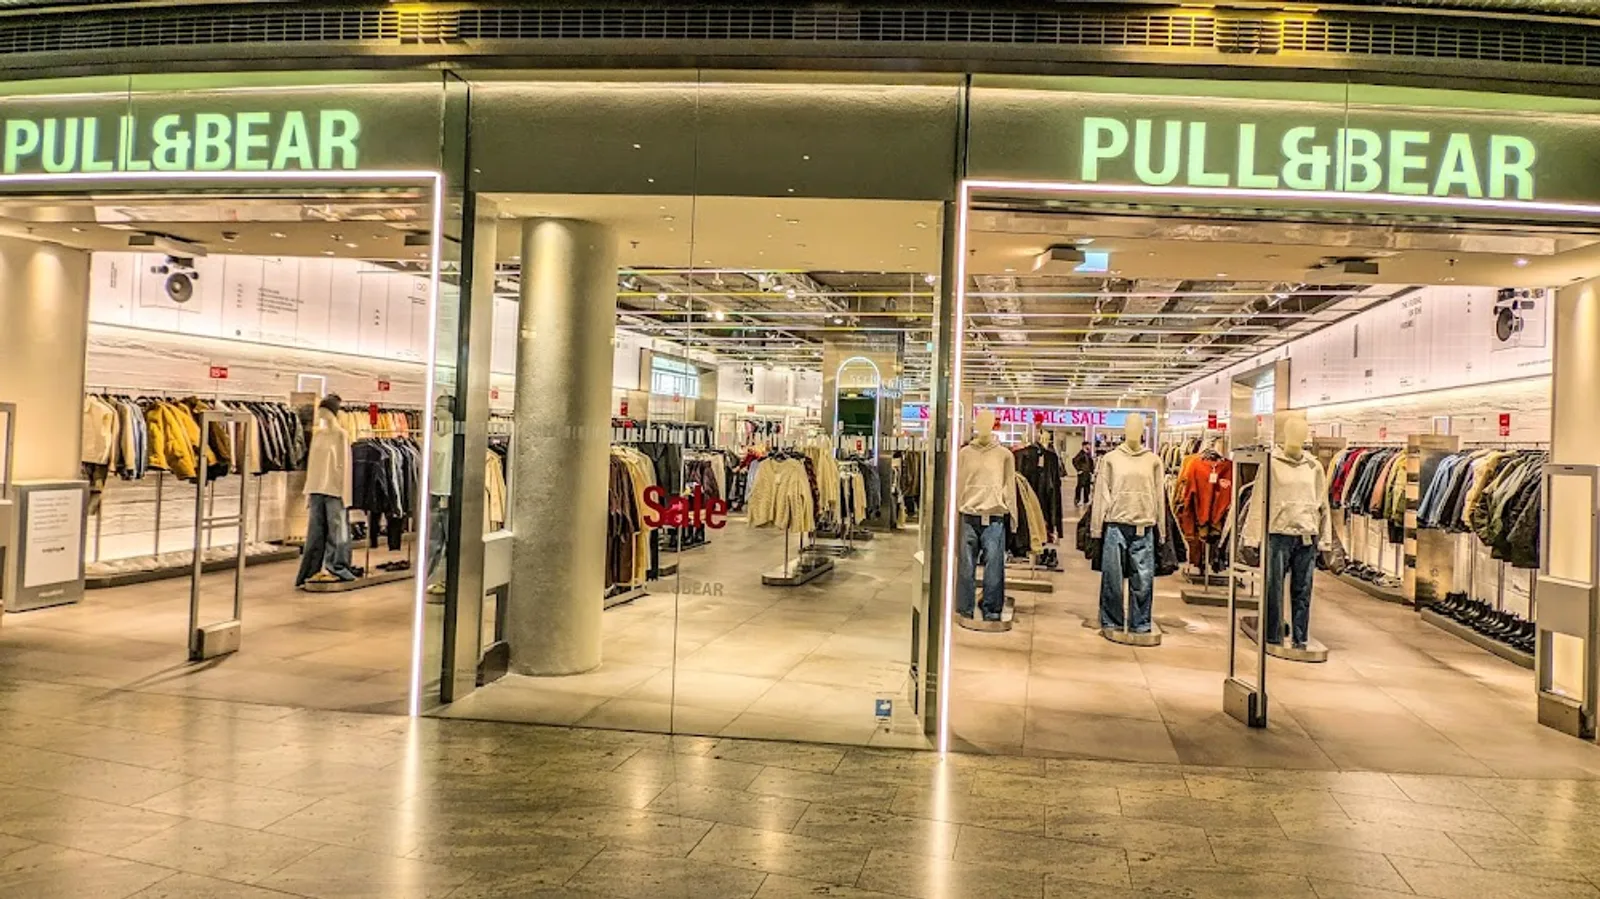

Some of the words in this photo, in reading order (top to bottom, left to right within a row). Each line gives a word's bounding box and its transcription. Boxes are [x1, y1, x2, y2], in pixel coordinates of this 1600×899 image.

[4, 110, 361, 173] PULL&BEAR
[1081, 117, 1536, 200] PULL&BEAR
[1033, 409, 1066, 424] ALE
[1072, 410, 1106, 425] SALE
[643, 485, 728, 529] Sale
